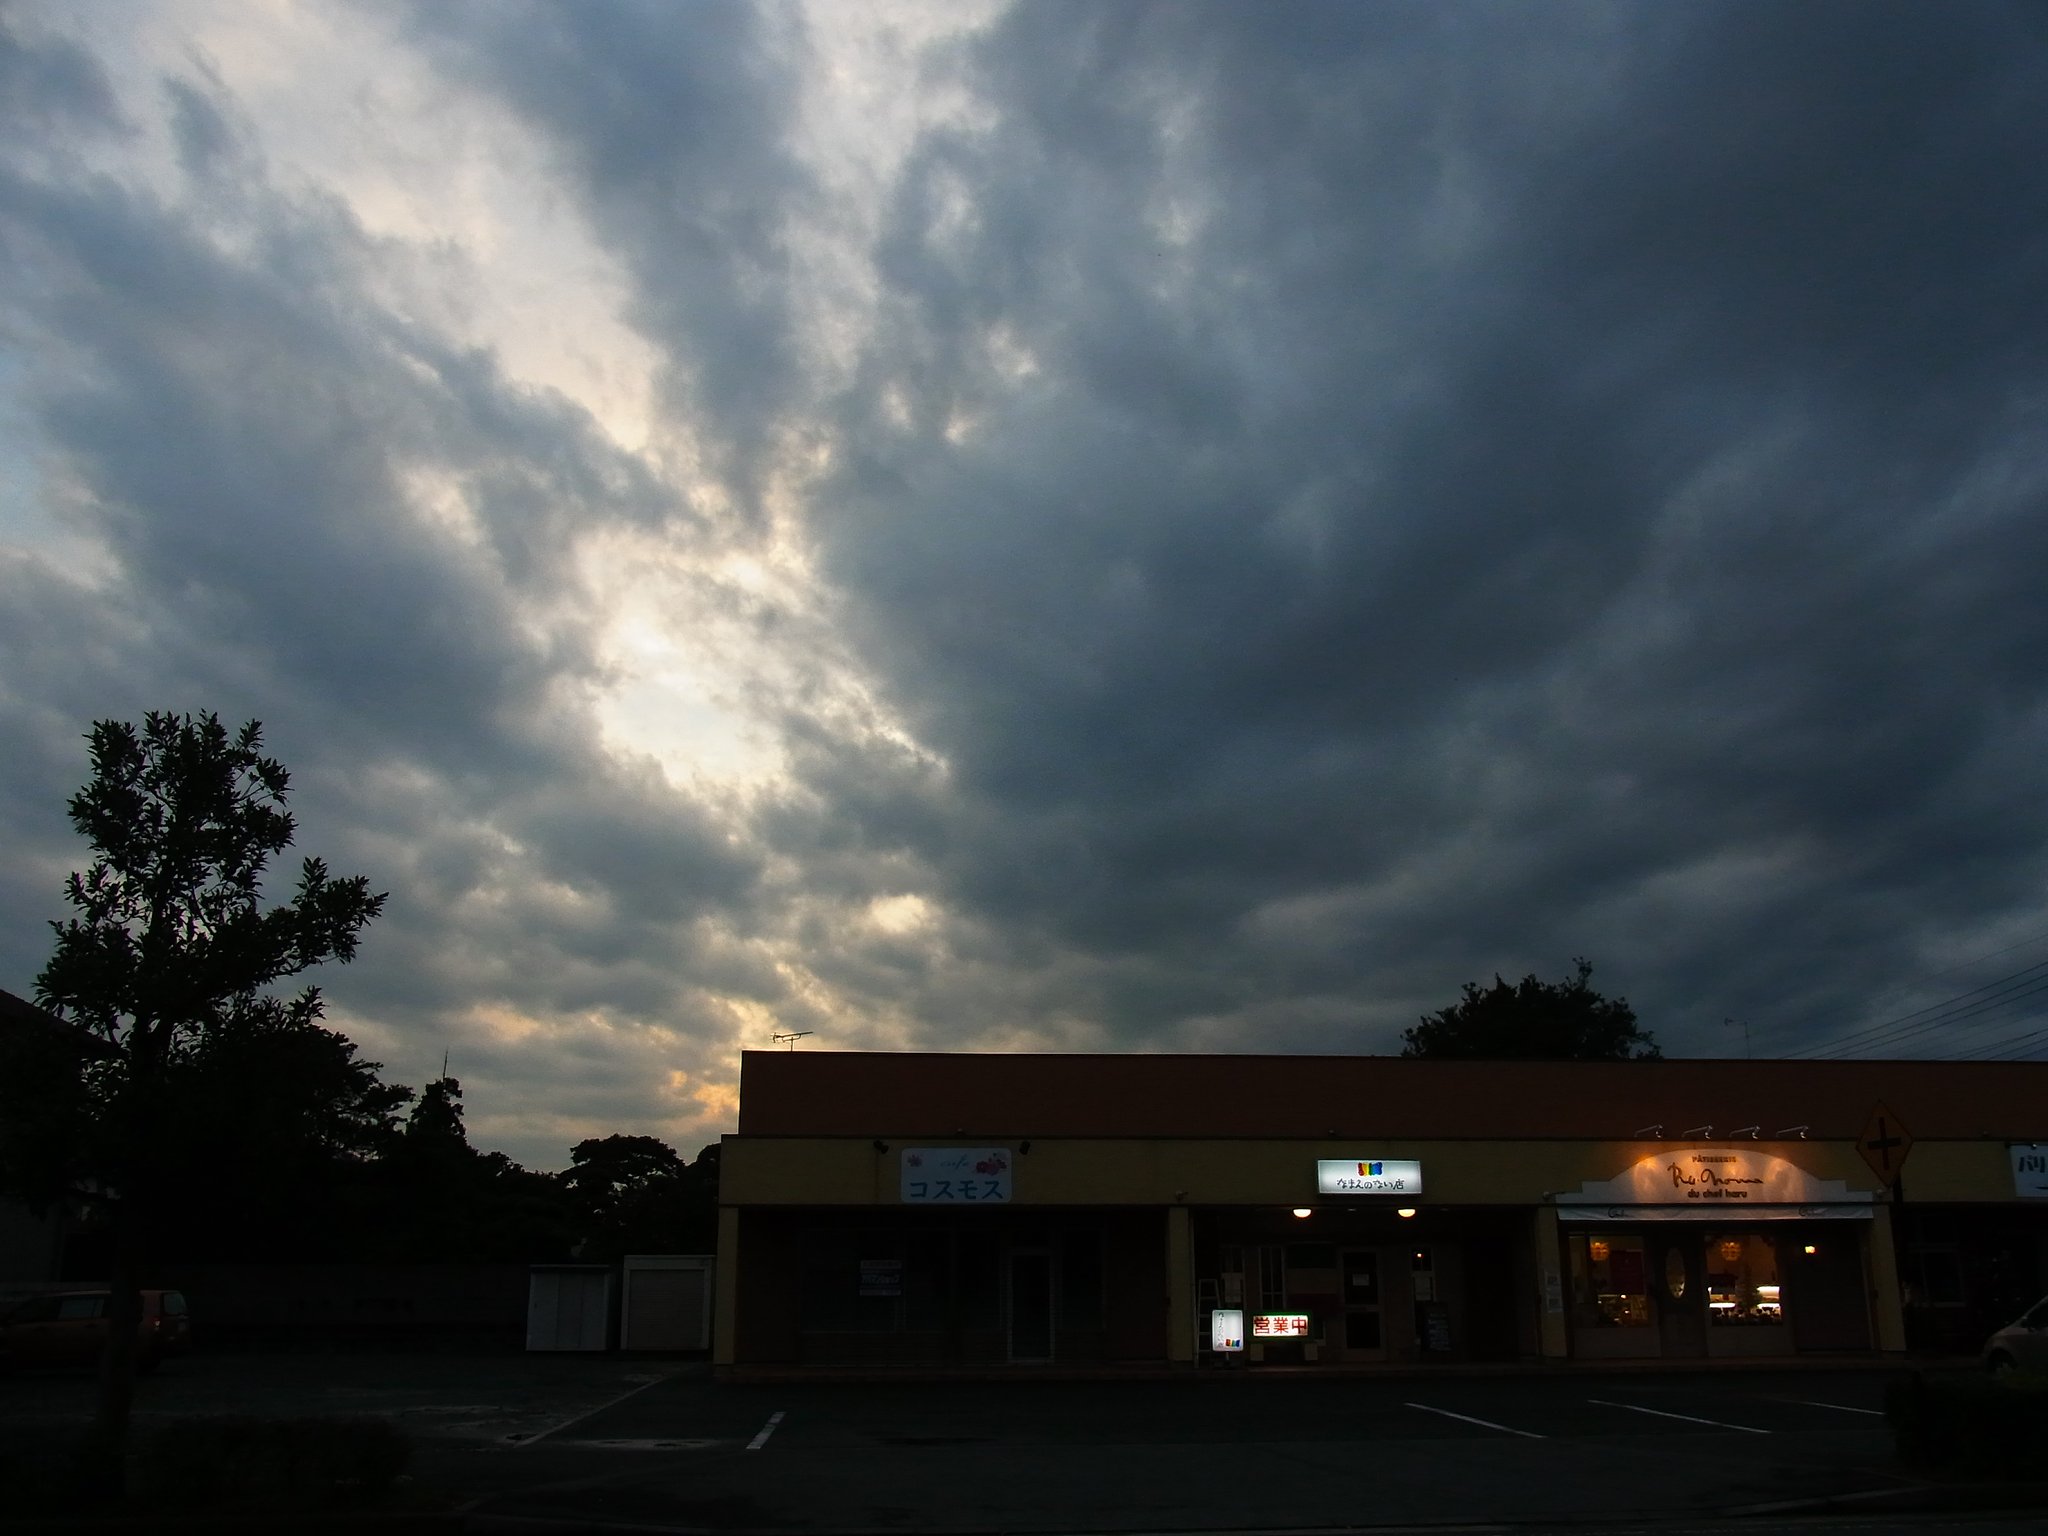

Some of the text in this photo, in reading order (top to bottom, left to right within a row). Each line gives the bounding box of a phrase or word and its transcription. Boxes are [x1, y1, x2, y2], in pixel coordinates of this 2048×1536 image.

[909, 1180, 1004, 1200] コスモス
[1336, 1178, 1405, 1190] なまえのない店
[1254, 1316, 1308, 1335] 営業中
